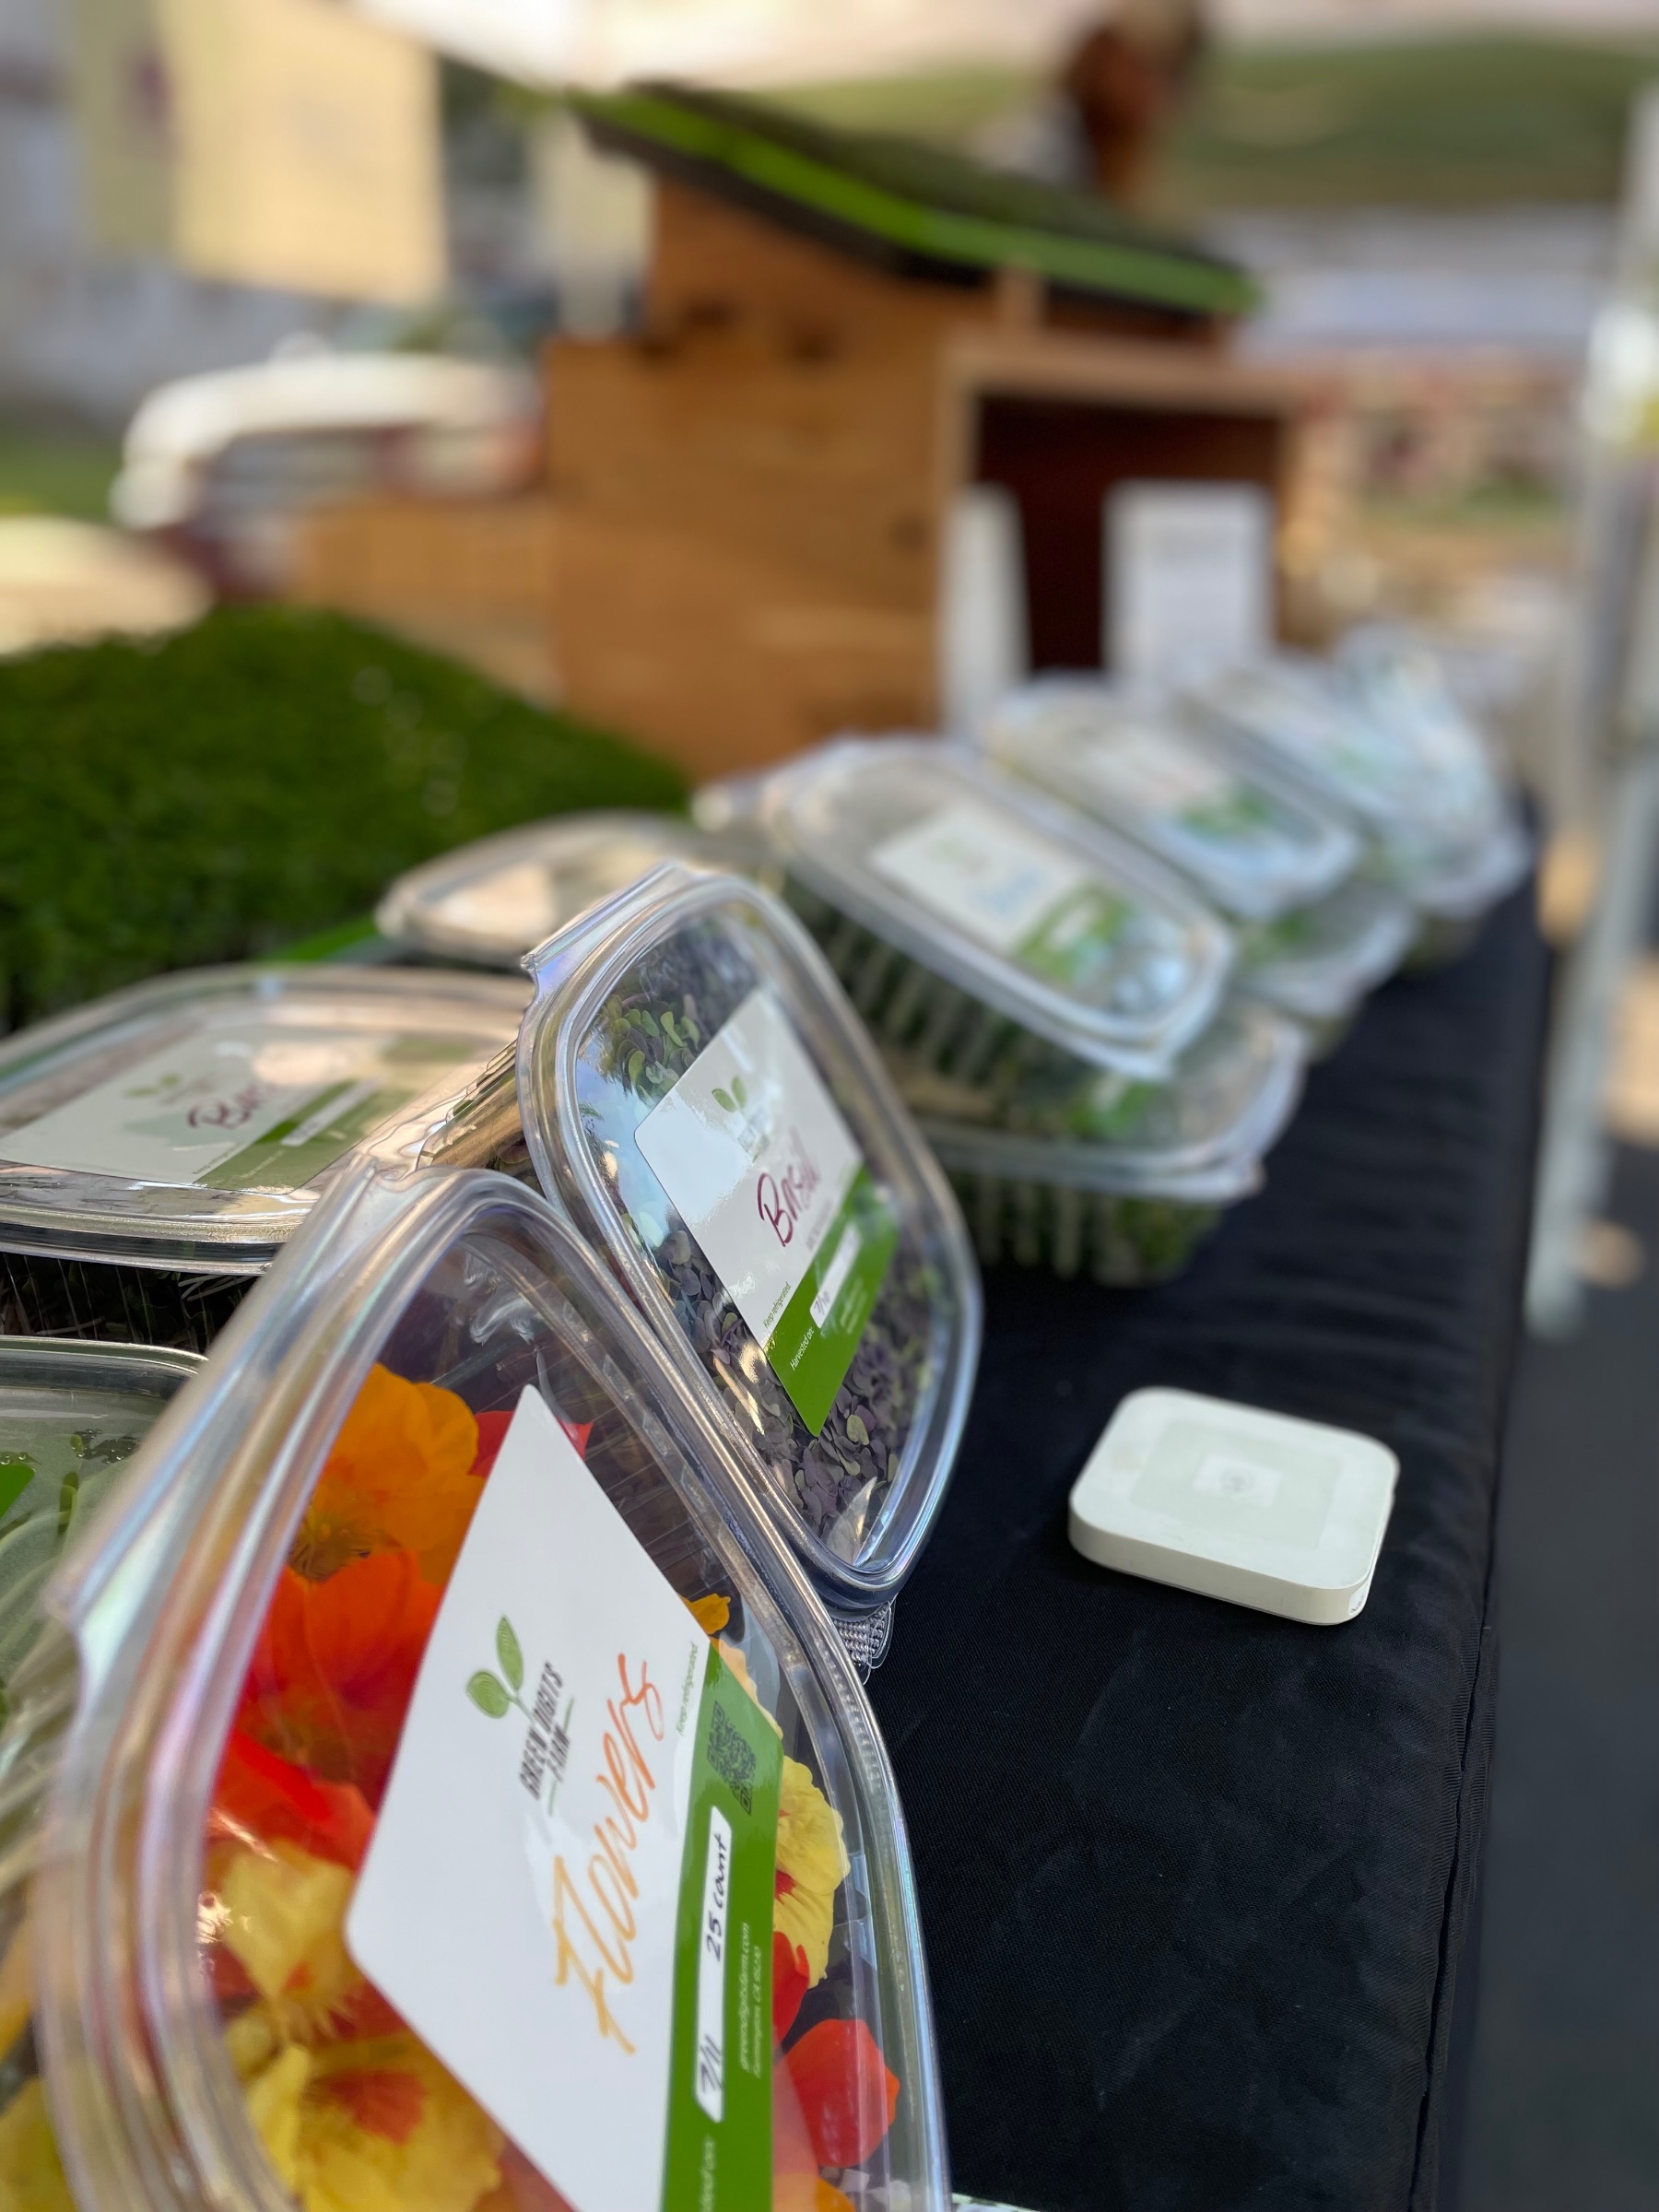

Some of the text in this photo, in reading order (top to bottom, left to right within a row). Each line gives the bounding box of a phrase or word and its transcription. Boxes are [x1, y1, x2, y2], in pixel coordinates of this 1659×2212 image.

[763, 1312, 775, 1329] Keep
[790, 1334, 809, 1371] Harvested
[519, 1661, 563, 1800] GREEN DIGITS
[546, 1723, 571, 1783] FARM
[553, 1653, 665, 2056] Flowers
[713, 1833, 729, 1910] count
[706, 1910, 722, 1963] 25
